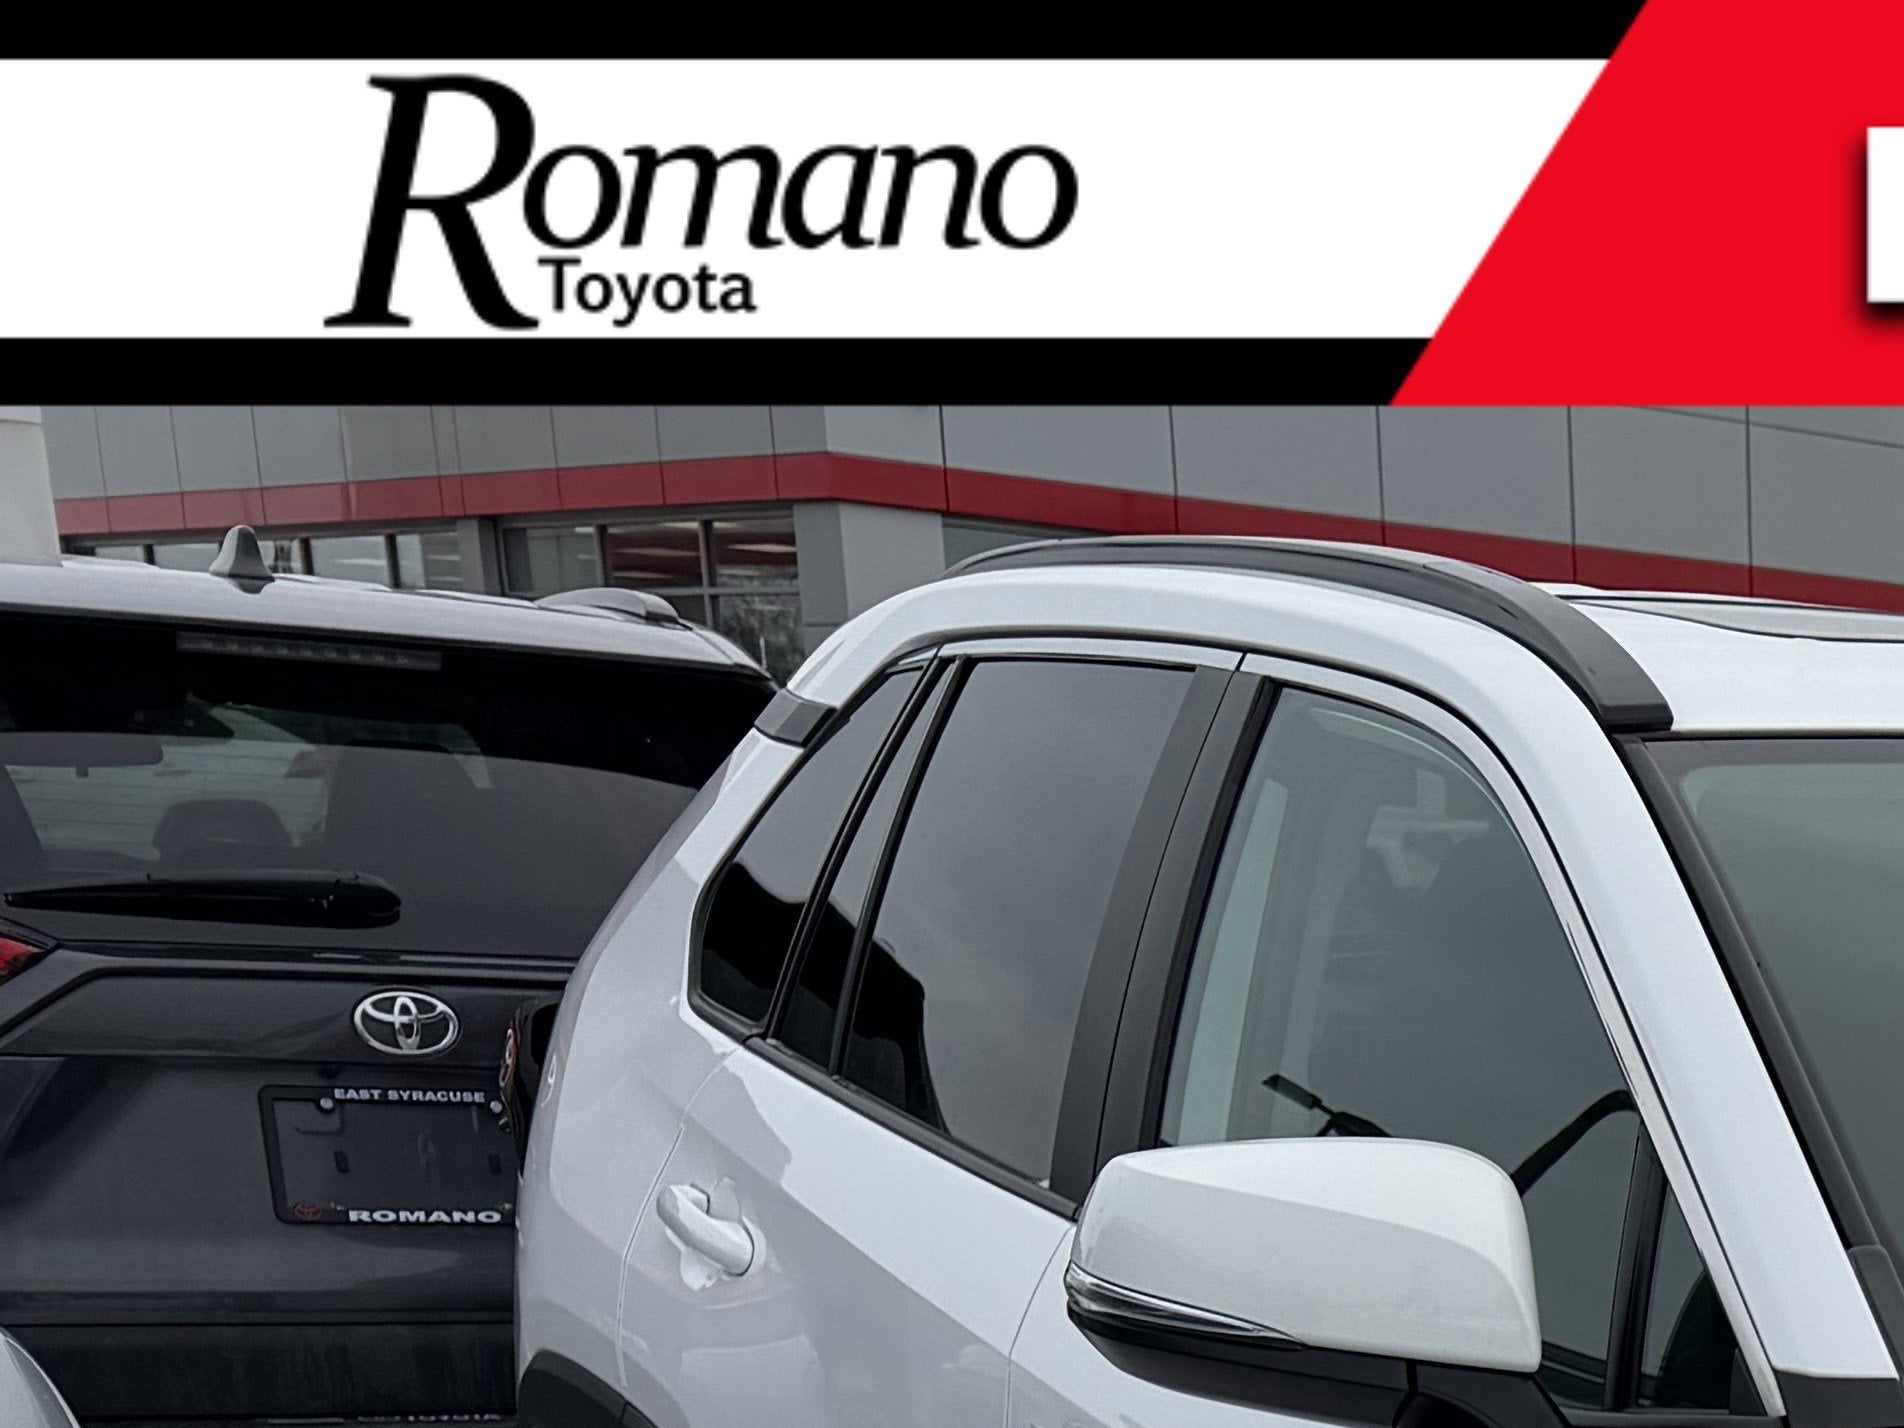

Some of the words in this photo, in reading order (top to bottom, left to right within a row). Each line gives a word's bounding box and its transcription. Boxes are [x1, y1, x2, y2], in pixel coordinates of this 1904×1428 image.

[334, 1088, 382, 1100] EAST
[387, 1089, 486, 1103] SYRACUSE
[348, 1210, 501, 1223] ROMANO
